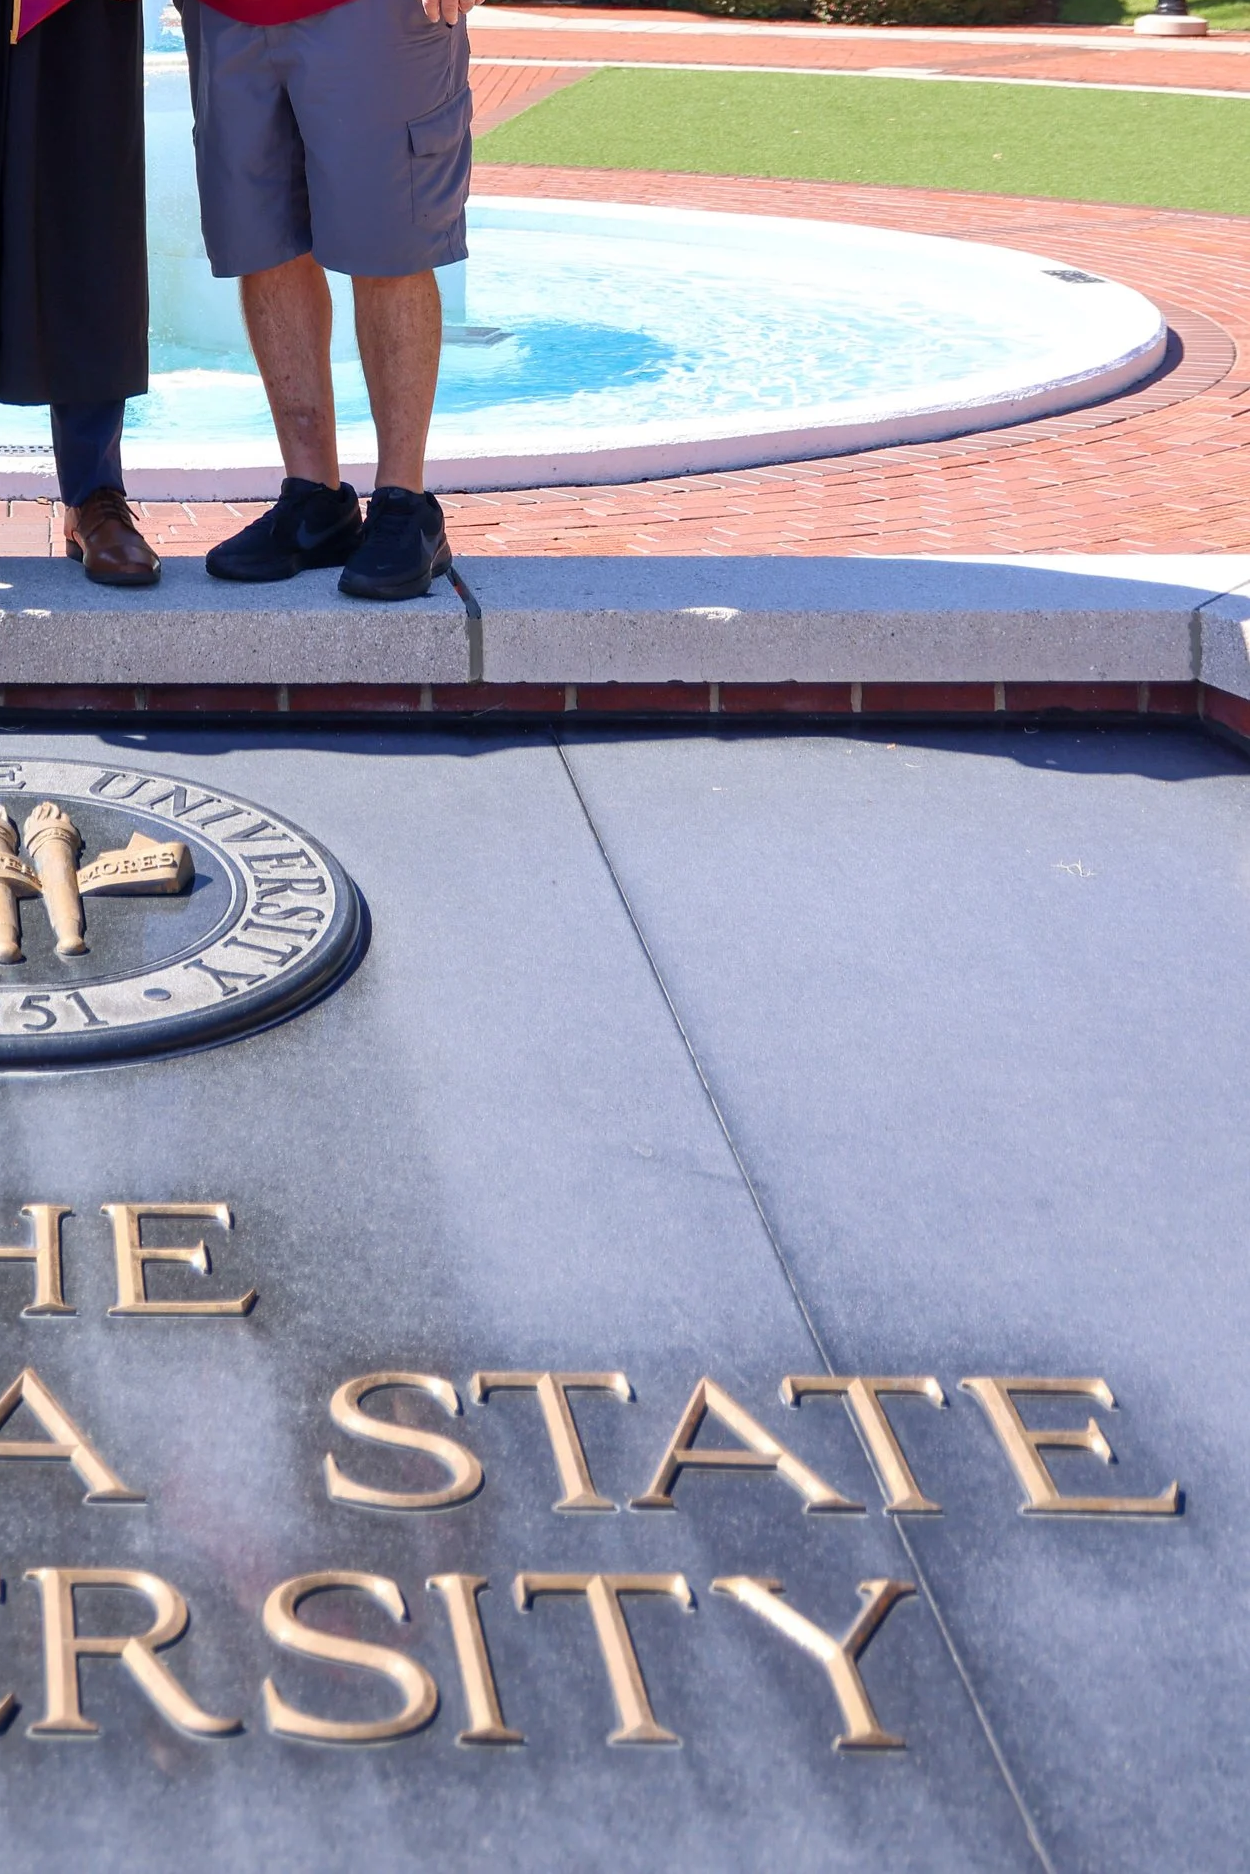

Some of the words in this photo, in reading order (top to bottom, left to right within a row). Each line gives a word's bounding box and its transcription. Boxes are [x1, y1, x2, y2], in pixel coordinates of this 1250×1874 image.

[79, 850, 178, 886] MORES
[88, 771, 328, 998] UNIVERSITY
[323, 1371, 1186, 1515] STATE
